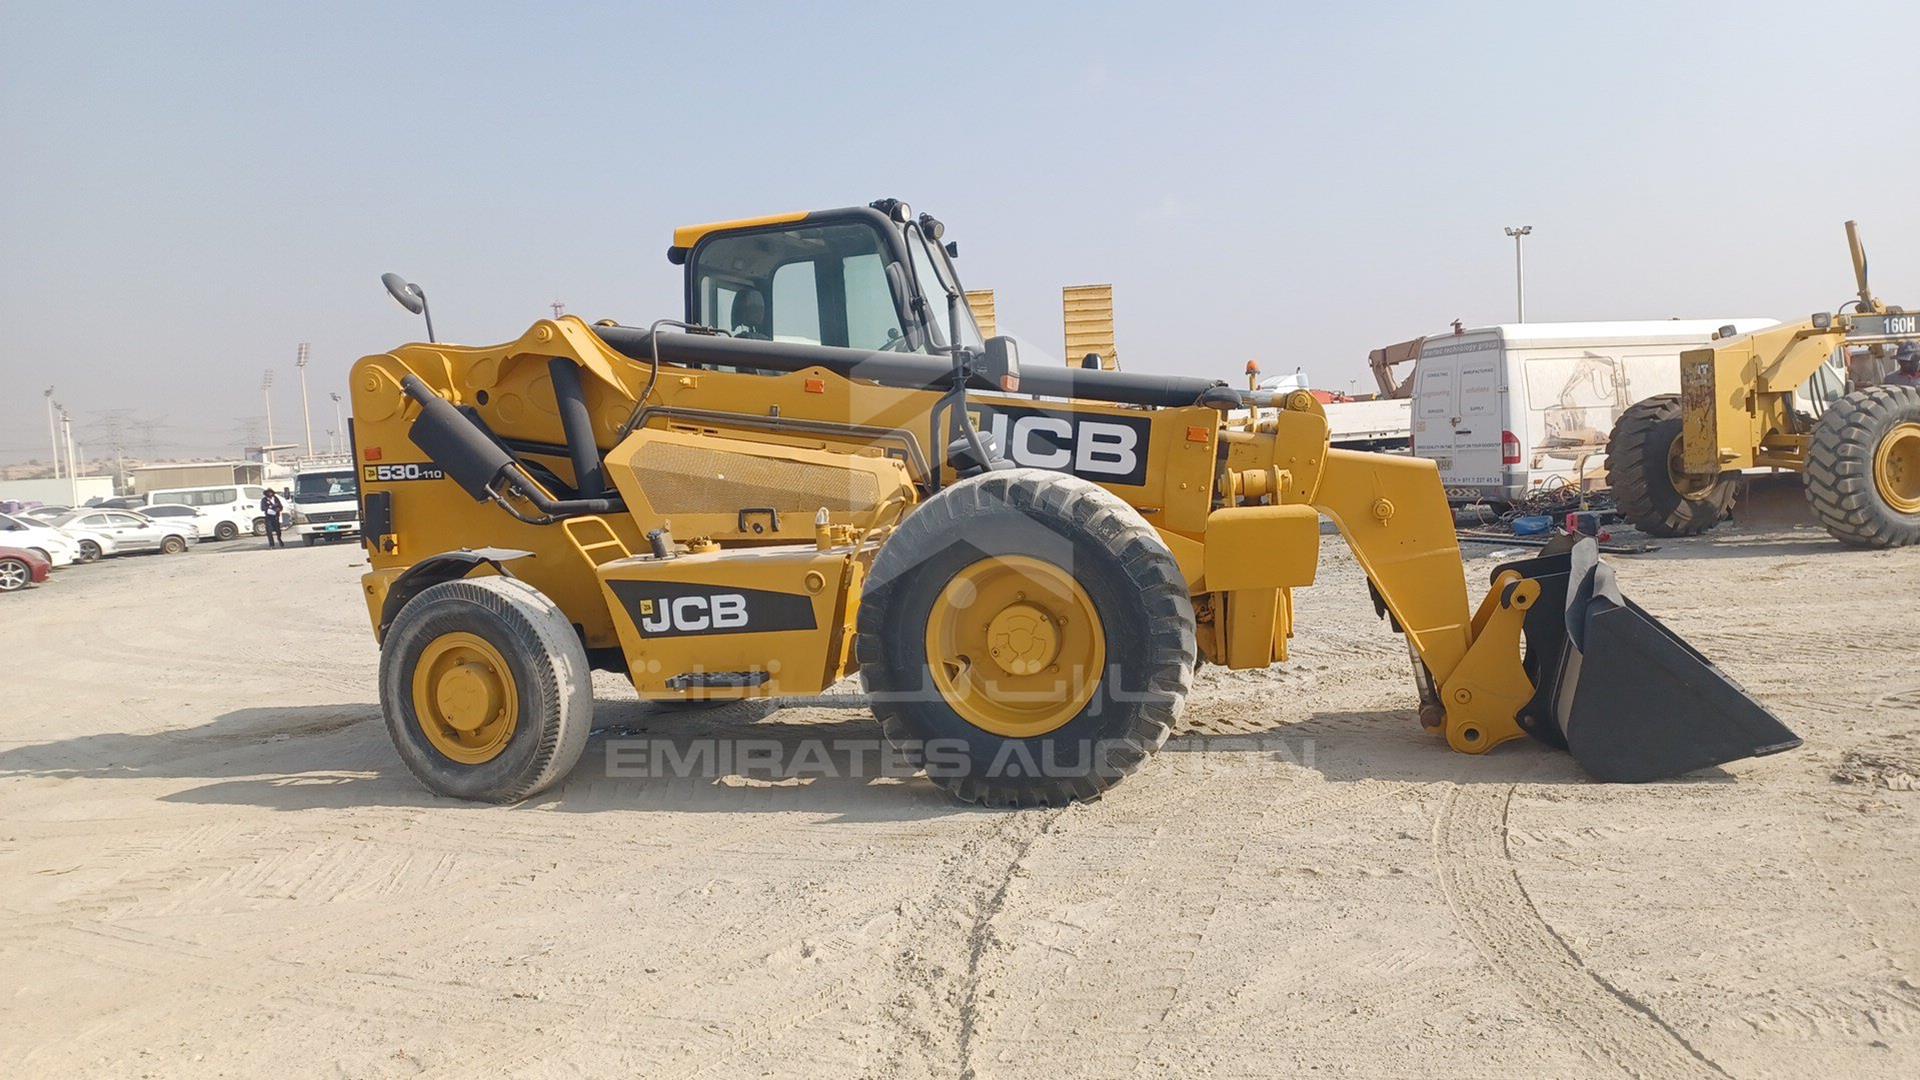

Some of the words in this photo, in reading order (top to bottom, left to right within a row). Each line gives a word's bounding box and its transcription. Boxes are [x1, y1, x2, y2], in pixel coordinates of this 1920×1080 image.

[1883, 316, 1916, 333] 160H
[378, 464, 442, 480] 530-110
[640, 593, 749, 633] JCB
